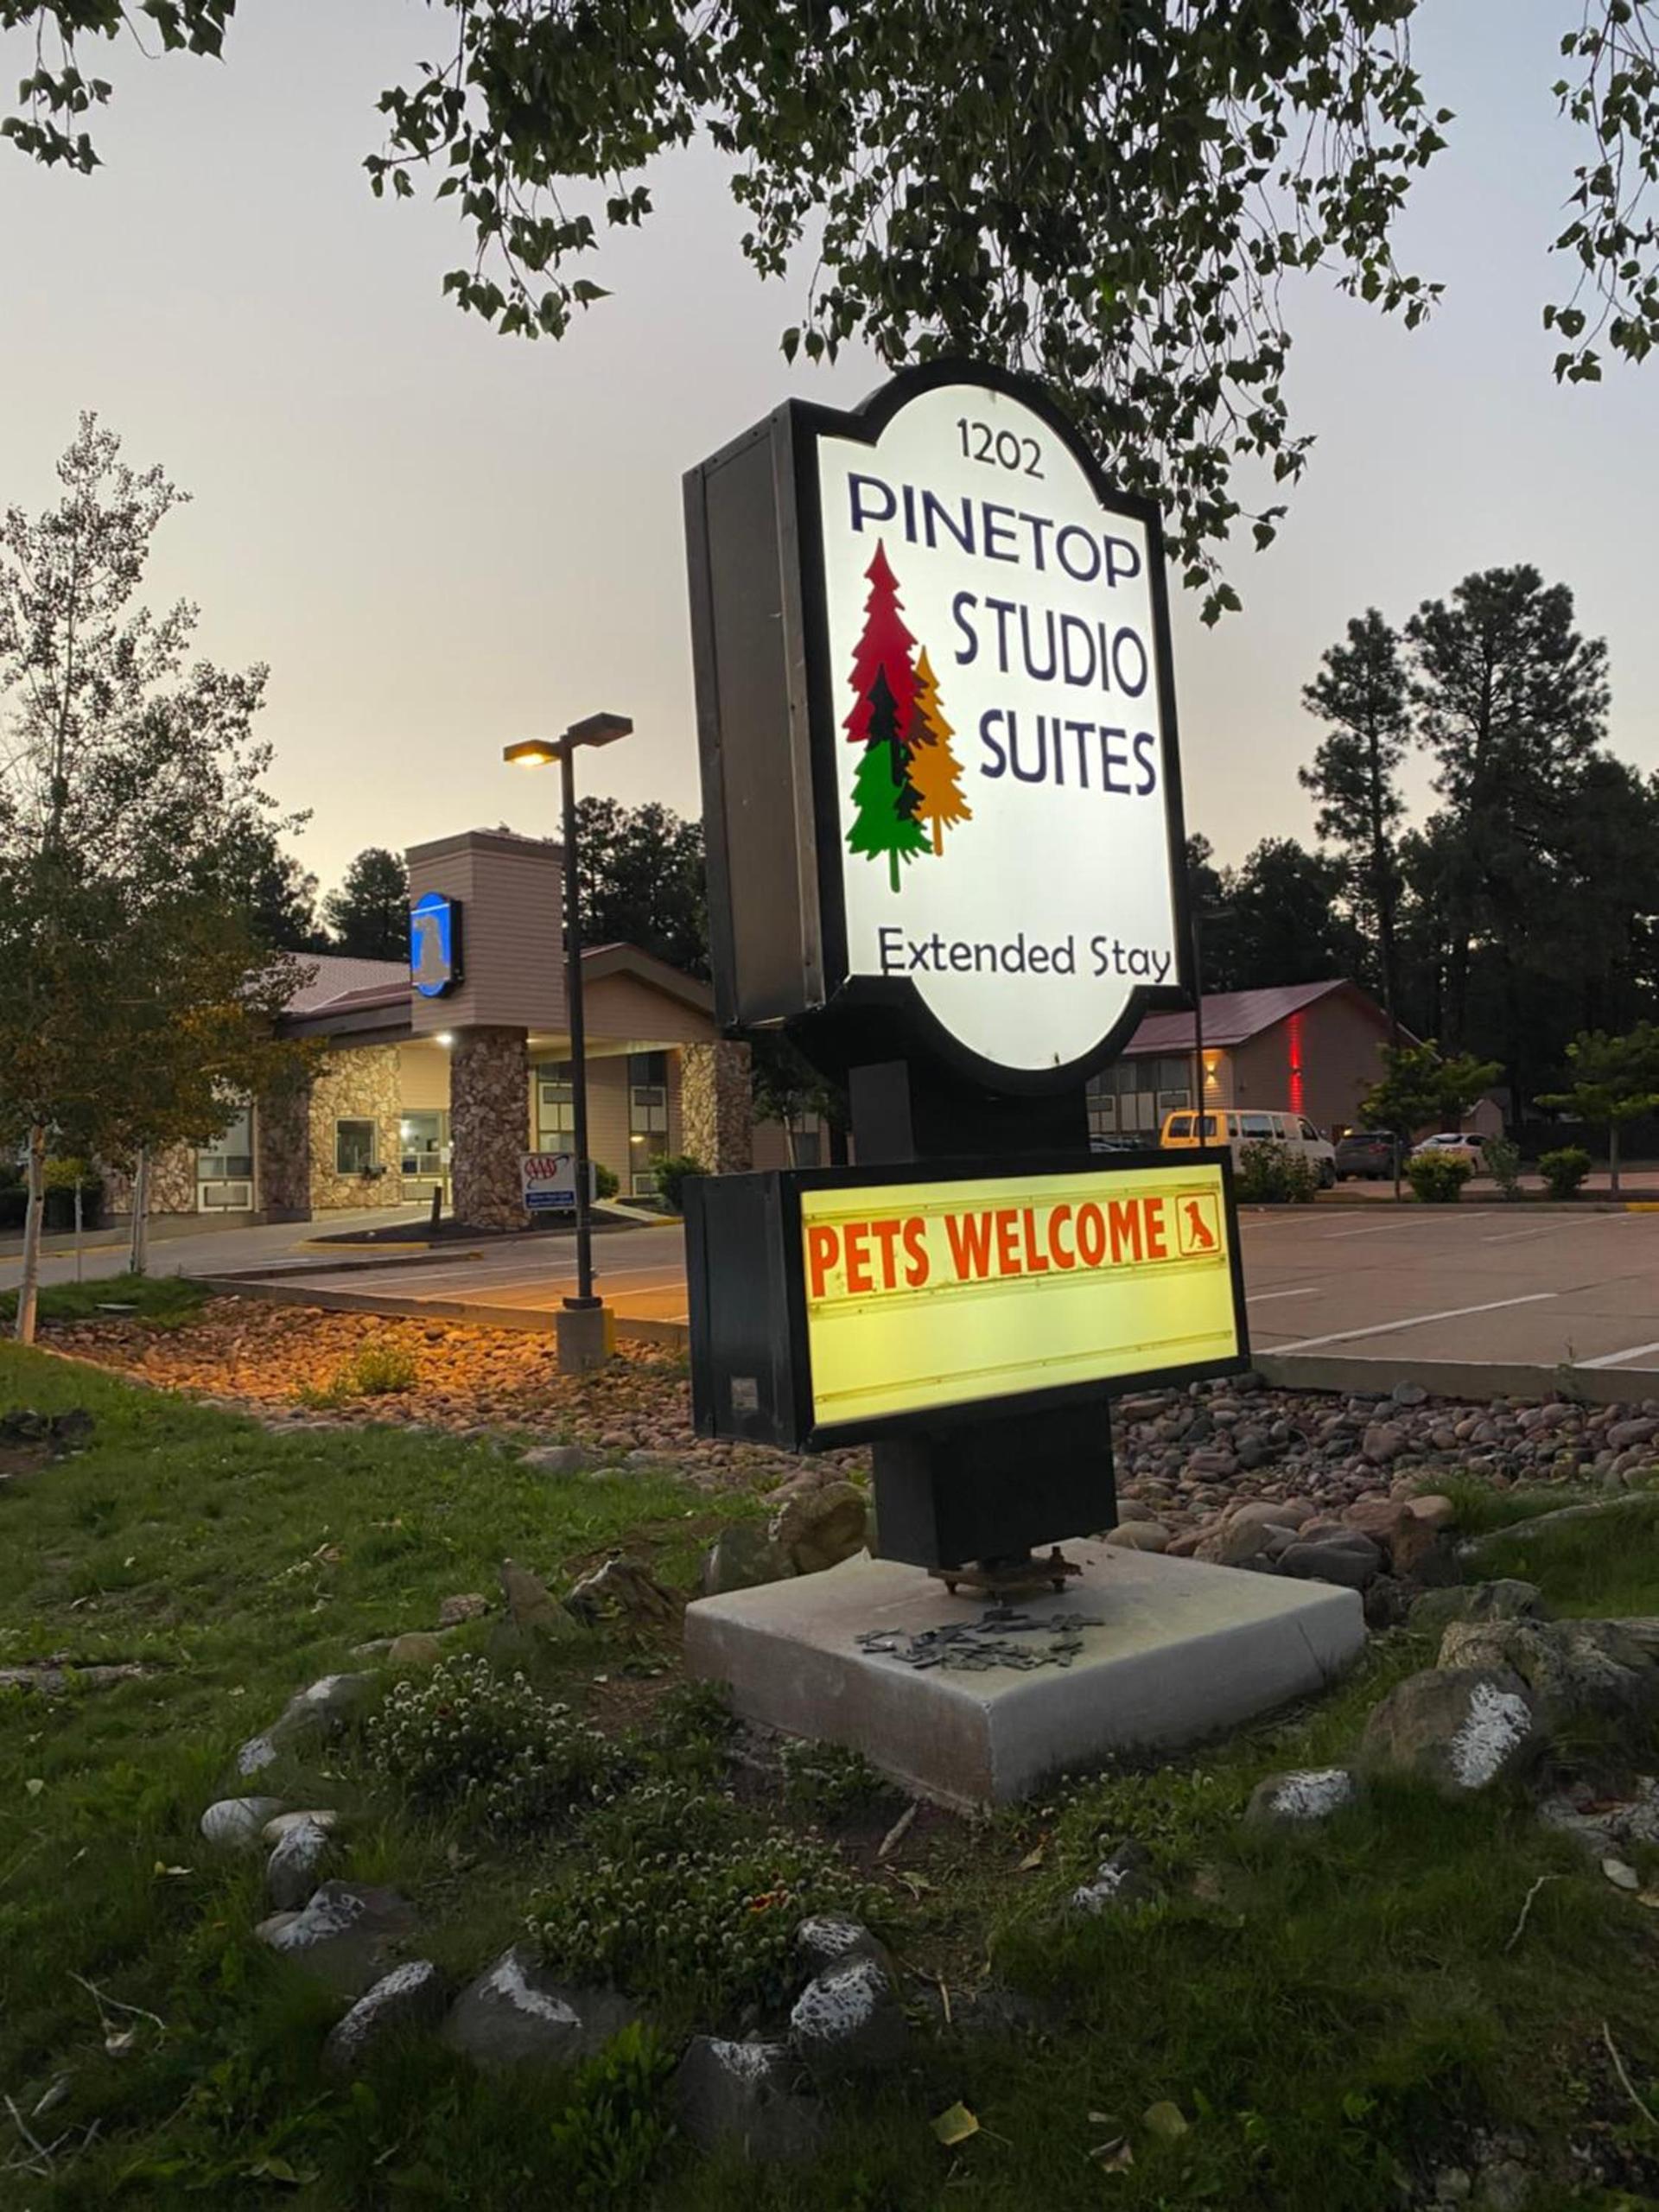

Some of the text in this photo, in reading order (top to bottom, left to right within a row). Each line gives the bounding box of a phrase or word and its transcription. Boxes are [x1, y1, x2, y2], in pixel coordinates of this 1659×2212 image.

[957, 418, 1045, 479] 1202
[849, 473, 1141, 588] PINETOP
[952, 592, 1148, 697] STUDIO
[979, 709, 1156, 795] SUITES
[878, 927, 1172, 983] Extended Stay
[525, 1158, 556, 1179] AAA
[807, 1198, 1167, 1298] PETS WELCOME
